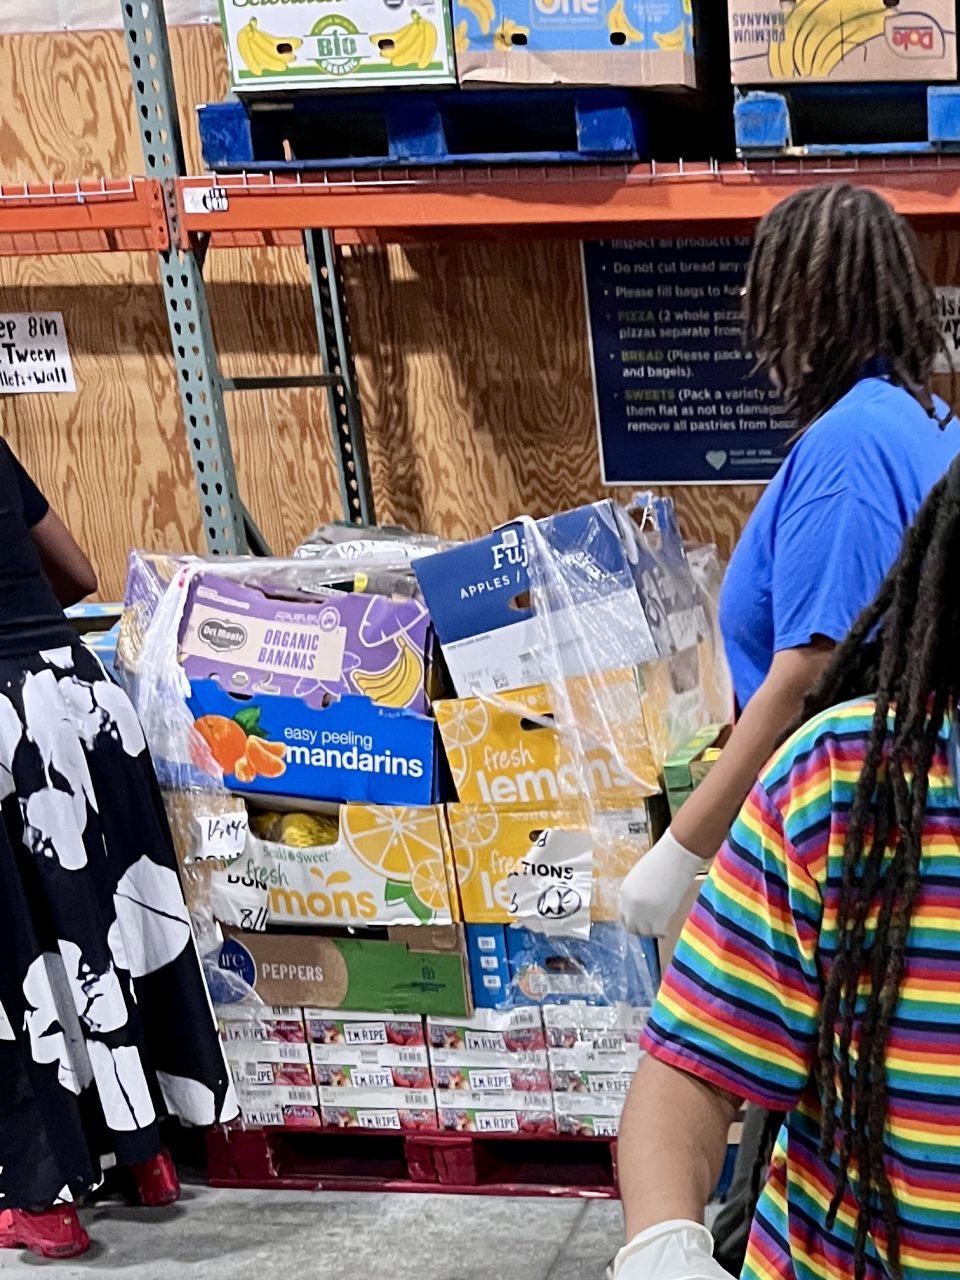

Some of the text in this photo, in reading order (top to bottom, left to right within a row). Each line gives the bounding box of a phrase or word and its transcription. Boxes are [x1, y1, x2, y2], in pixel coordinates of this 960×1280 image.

[733, 29, 786, 43] PREMIUM
[891, 29, 934, 51] Dole
[614, 262, 631, 273] Do
[634, 262, 654, 273] not
[657, 262, 676, 273] cut
[680, 261, 715, 273] bread
[615, 286, 720, 300] Please fill bags to
[675, 310, 710, 321] whole
[619, 326, 656, 340] pizzas
[659, 326, 710, 340] separate
[623, 366, 644, 377] and
[725, 388, 766, 402] variety
[626, 404, 733, 416] them flat as not to
[627, 418, 767, 434] remove all pastries from
[460, 575, 511, 600] APPLES
[264, 629, 319, 652] ORGANIC
[257, 649, 317, 671] BANANAS
[284, 728, 373, 751] easy peeling
[285, 743, 424, 777] mandarins
[483, 739, 535, 771] fresh
[246, 859, 290, 886] fresh
[261, 962, 324, 982] PEPPERS
[362, 1028, 385, 1041] RIPE
[368, 1073, 392, 1086] RIPE
[487, 1076, 510, 1089] RIPE
[376, 1114, 399, 1128] RIPE
[494, 1117, 517, 1130] RIPE
